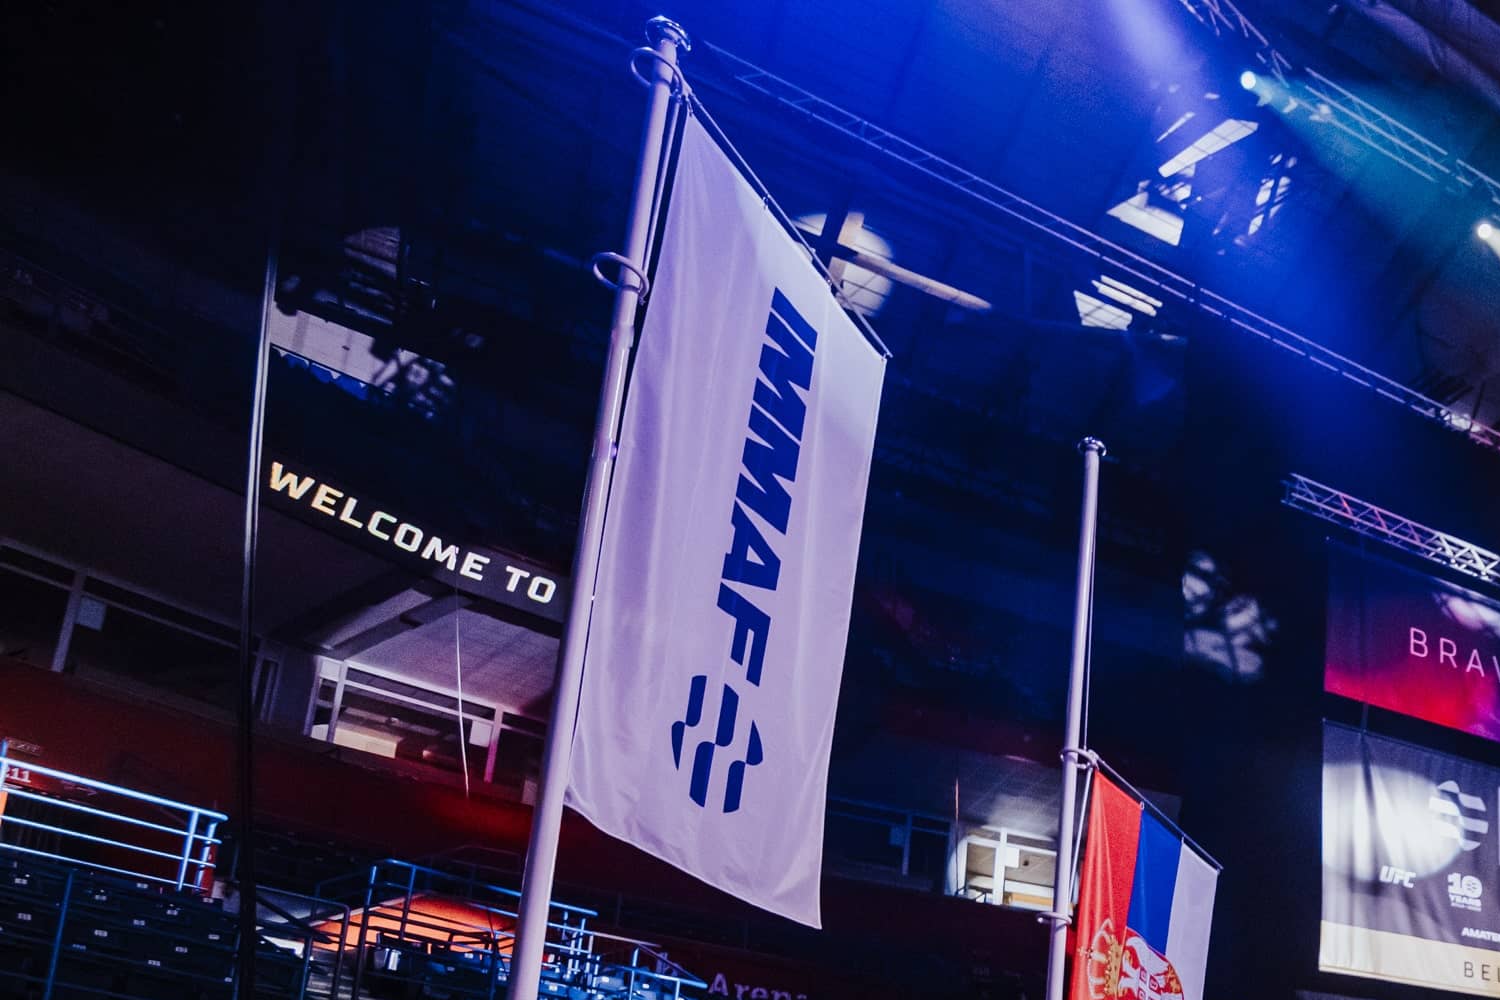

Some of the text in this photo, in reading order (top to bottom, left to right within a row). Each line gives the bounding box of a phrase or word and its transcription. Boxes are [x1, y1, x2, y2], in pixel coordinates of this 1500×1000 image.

[716, 286, 818, 688] IMMAF
[268, 461, 556, 605] WELCOME TO
[1379, 865, 1417, 888] UFC
[1447, 872, 1482, 898] 10
